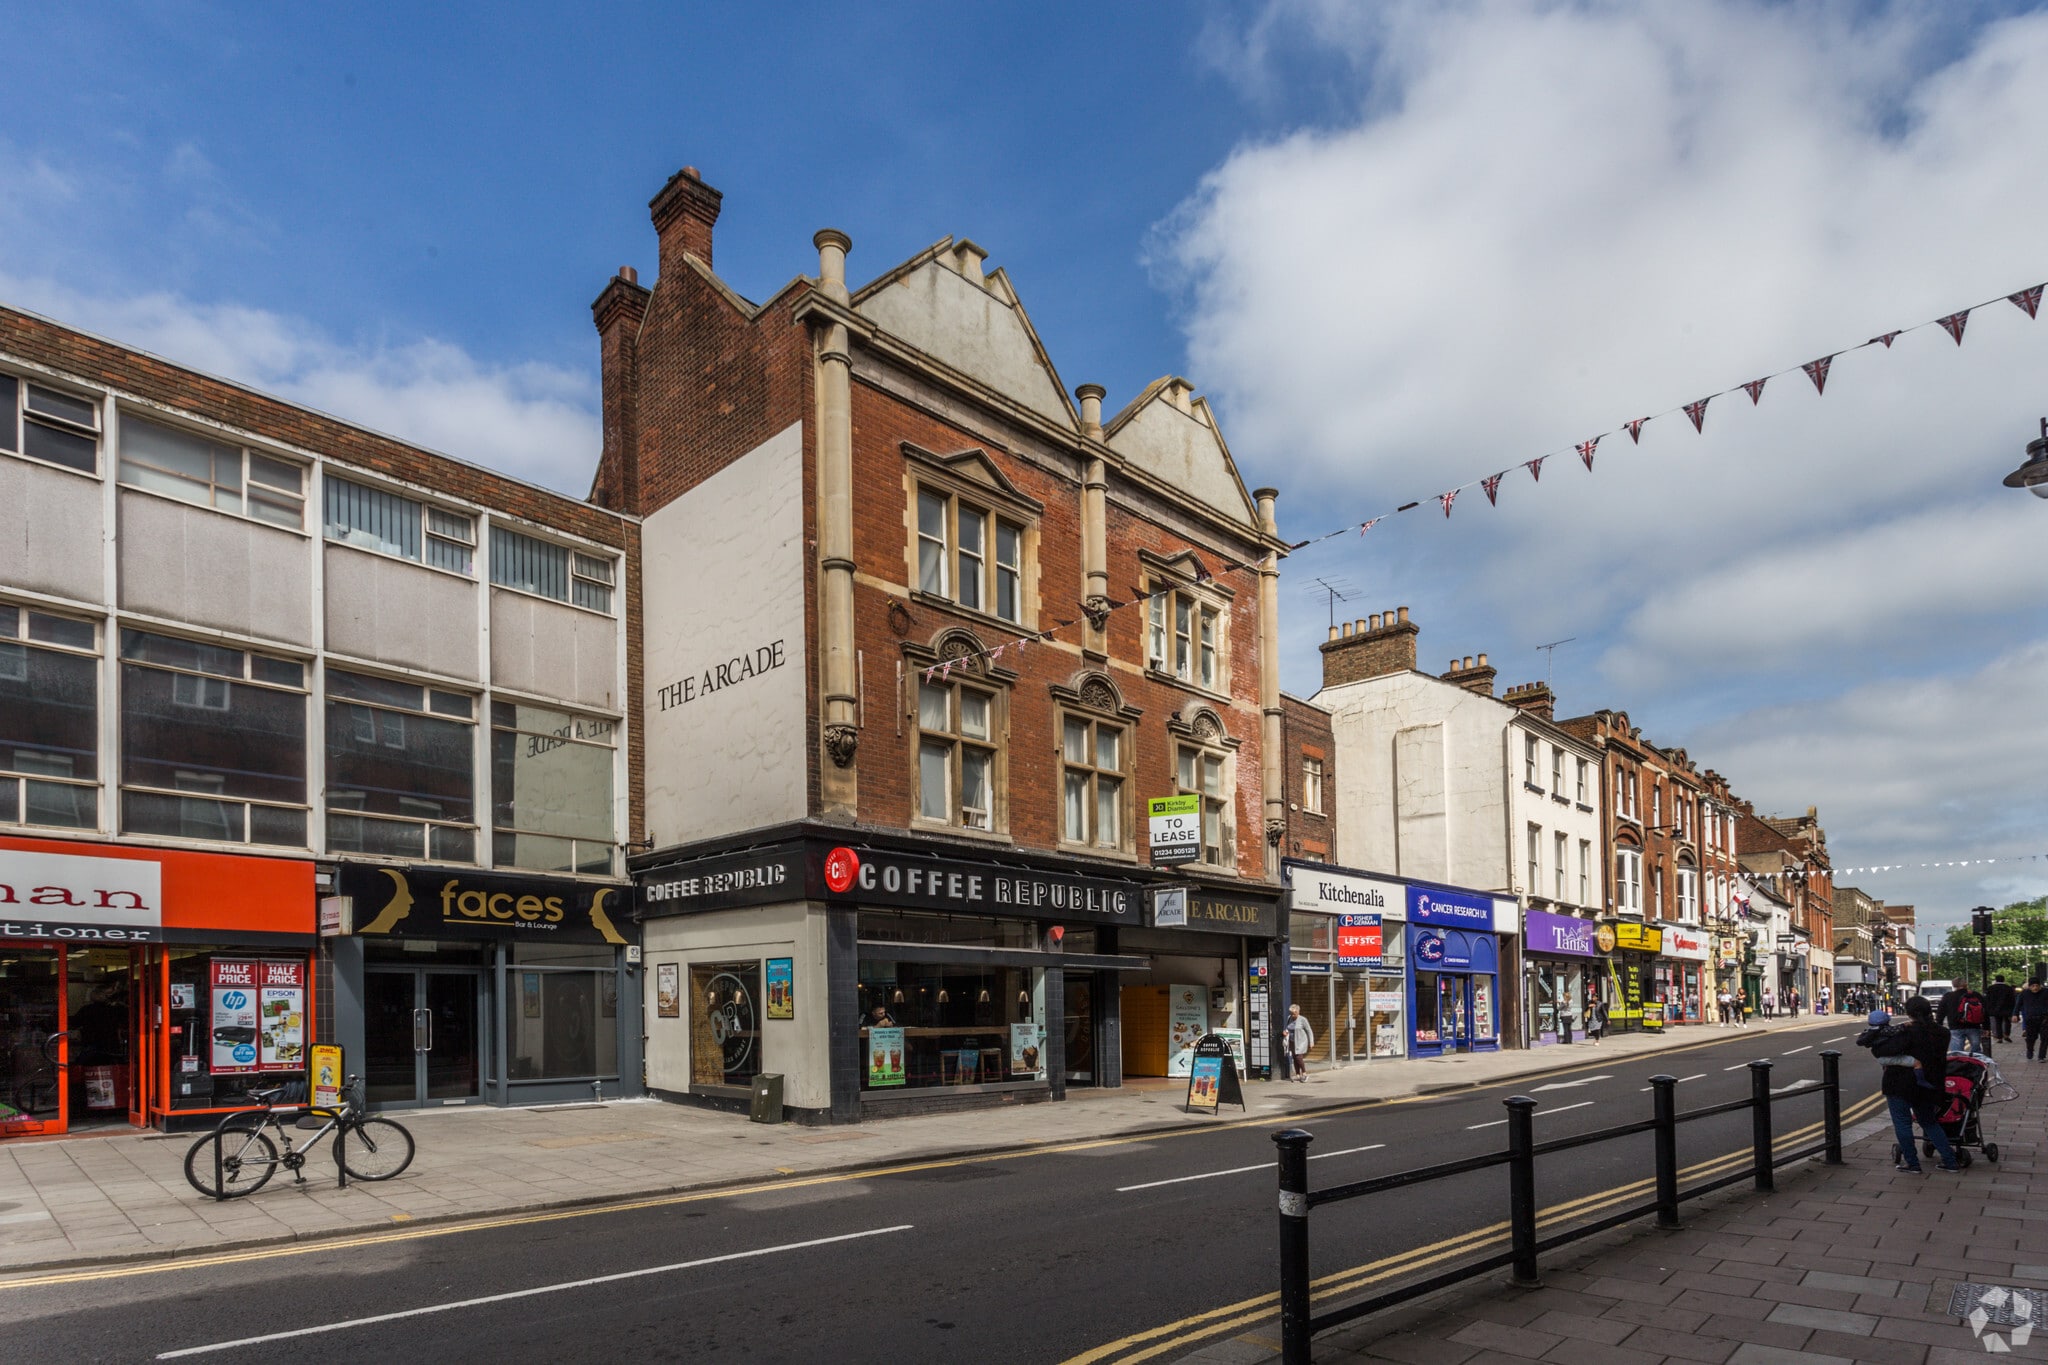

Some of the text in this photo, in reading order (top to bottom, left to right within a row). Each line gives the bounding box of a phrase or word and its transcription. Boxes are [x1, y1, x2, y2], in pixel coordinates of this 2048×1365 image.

[658, 639, 786, 712] THE ARCADE
[1165, 818, 1183, 829] TO
[1154, 830, 1195, 843] LEASE
[1154, 848, 1172, 856] 01234
[646, 864, 785, 902] COFFEE REPUBLIC
[858, 862, 1127, 914] COFFEE REPUBLIC
[440, 879, 565, 922] faces
[1318, 881, 1385, 908] Kitchenalia
[1164, 899, 1177, 907] THE
[1204, 902, 1260, 923] ARCADE
[1431, 902, 1488, 919] CANCER RESEARCH UK
[533, 922, 558, 930] Lounge
[1344, 937, 1376, 945] LET STC
[220, 964, 250, 974] HALF
[269, 966, 296, 975] HALF
[218, 974, 251, 984] PRICE
[267, 975, 297, 984] PRICE
[223, 991, 246, 1010] hp
